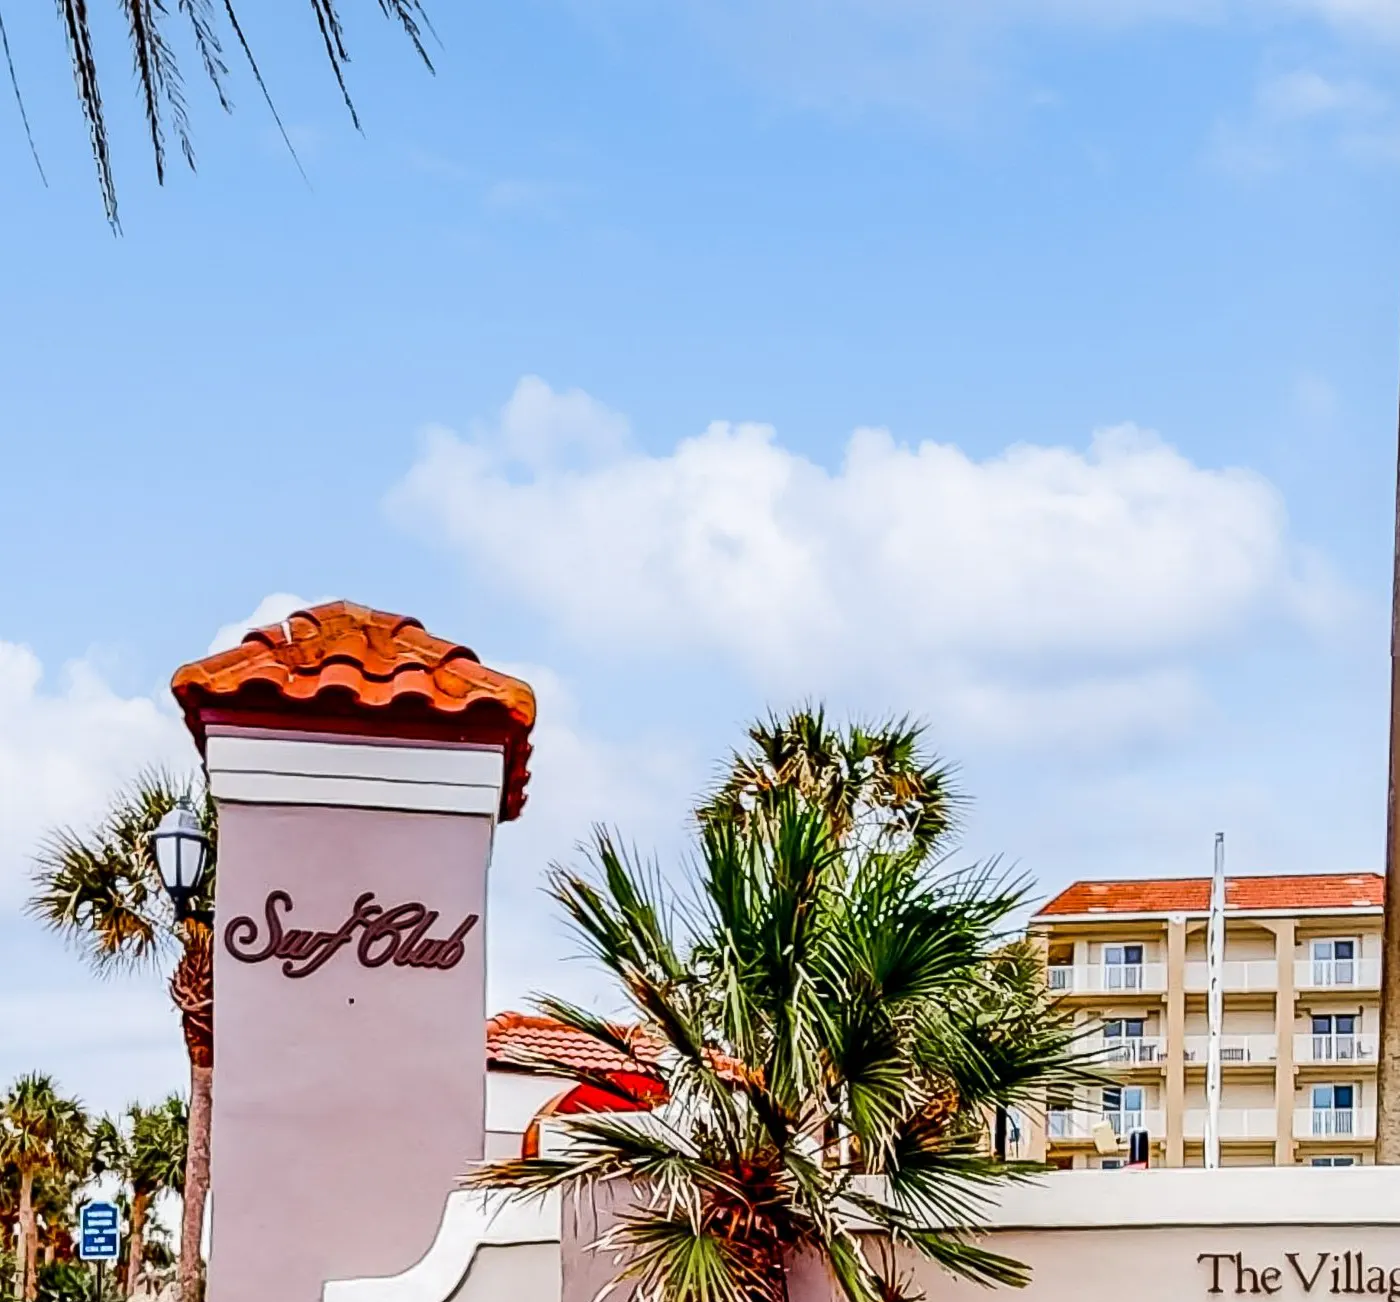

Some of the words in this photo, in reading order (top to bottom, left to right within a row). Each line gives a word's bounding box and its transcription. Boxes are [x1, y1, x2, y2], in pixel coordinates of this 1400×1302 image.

[224, 890, 375, 979] Surf
[356, 902, 479, 970] Club
[1197, 1252, 1283, 1294] The
